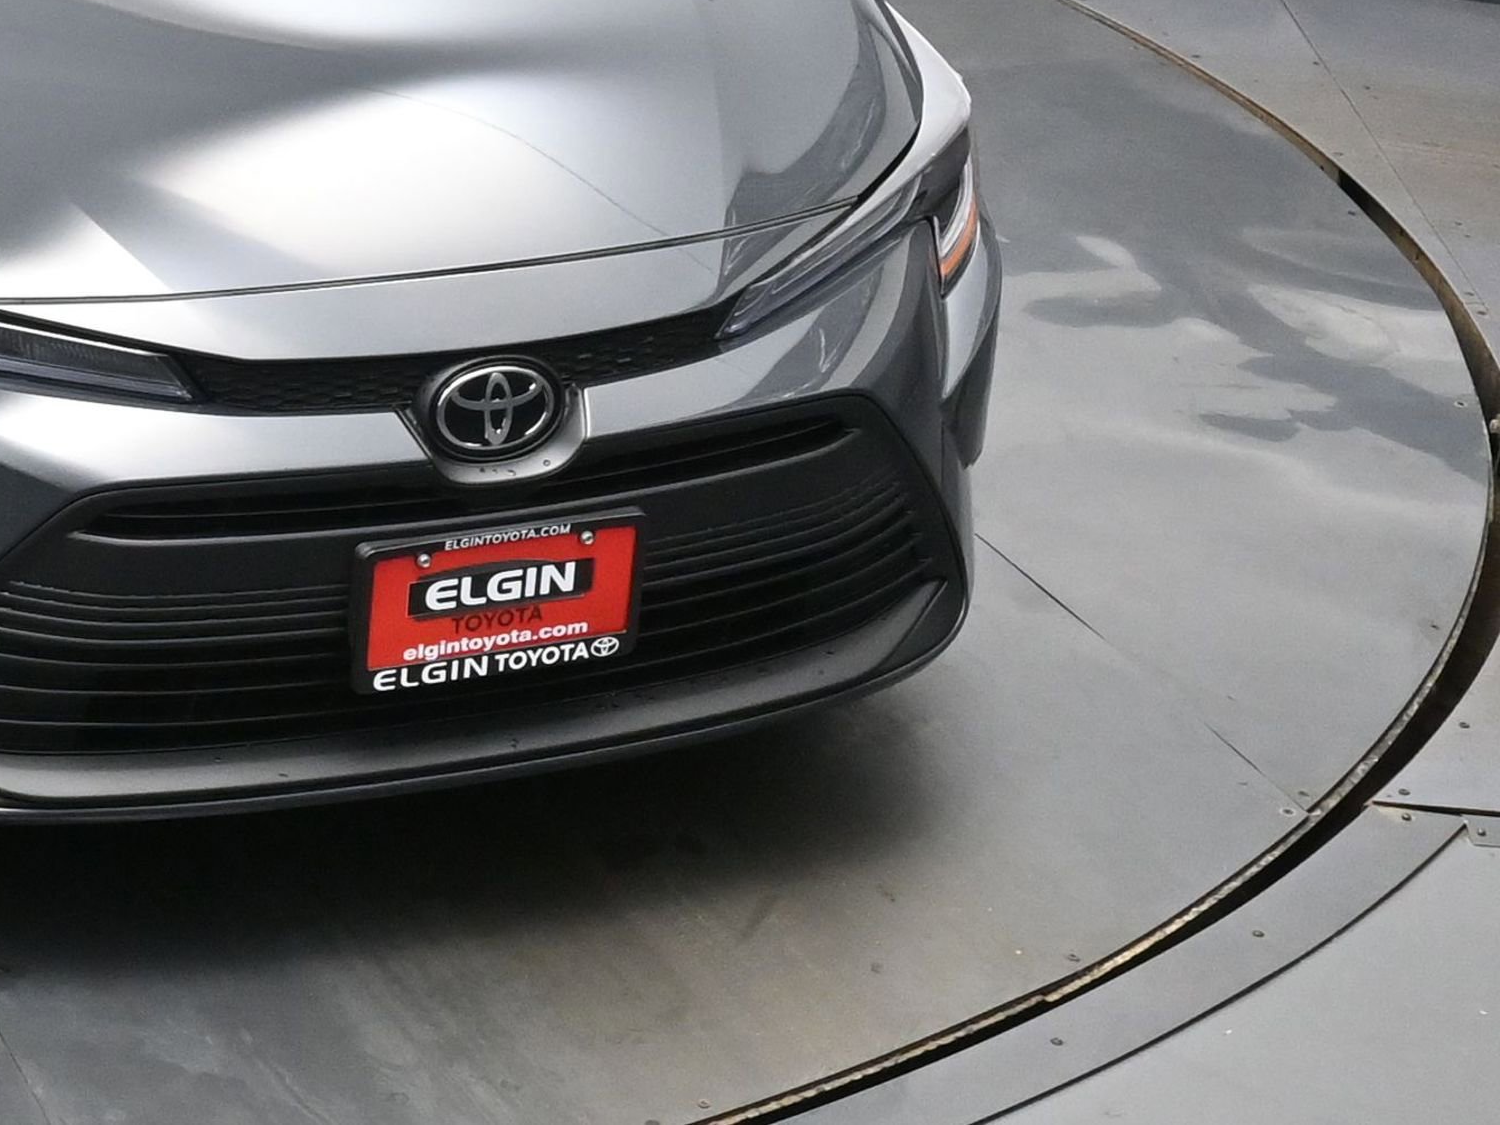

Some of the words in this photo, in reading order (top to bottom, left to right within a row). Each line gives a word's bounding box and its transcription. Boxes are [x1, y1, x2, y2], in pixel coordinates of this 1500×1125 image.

[444, 523, 571, 551] ELGINTOYOTA.COM
[425, 561, 576, 611] ELGIN
[452, 604, 543, 634] TOYOTA
[403, 621, 588, 661] elgintoyota.com
[373, 656, 488, 692] ELGIN
[495, 641, 590, 674] TOYOTA
